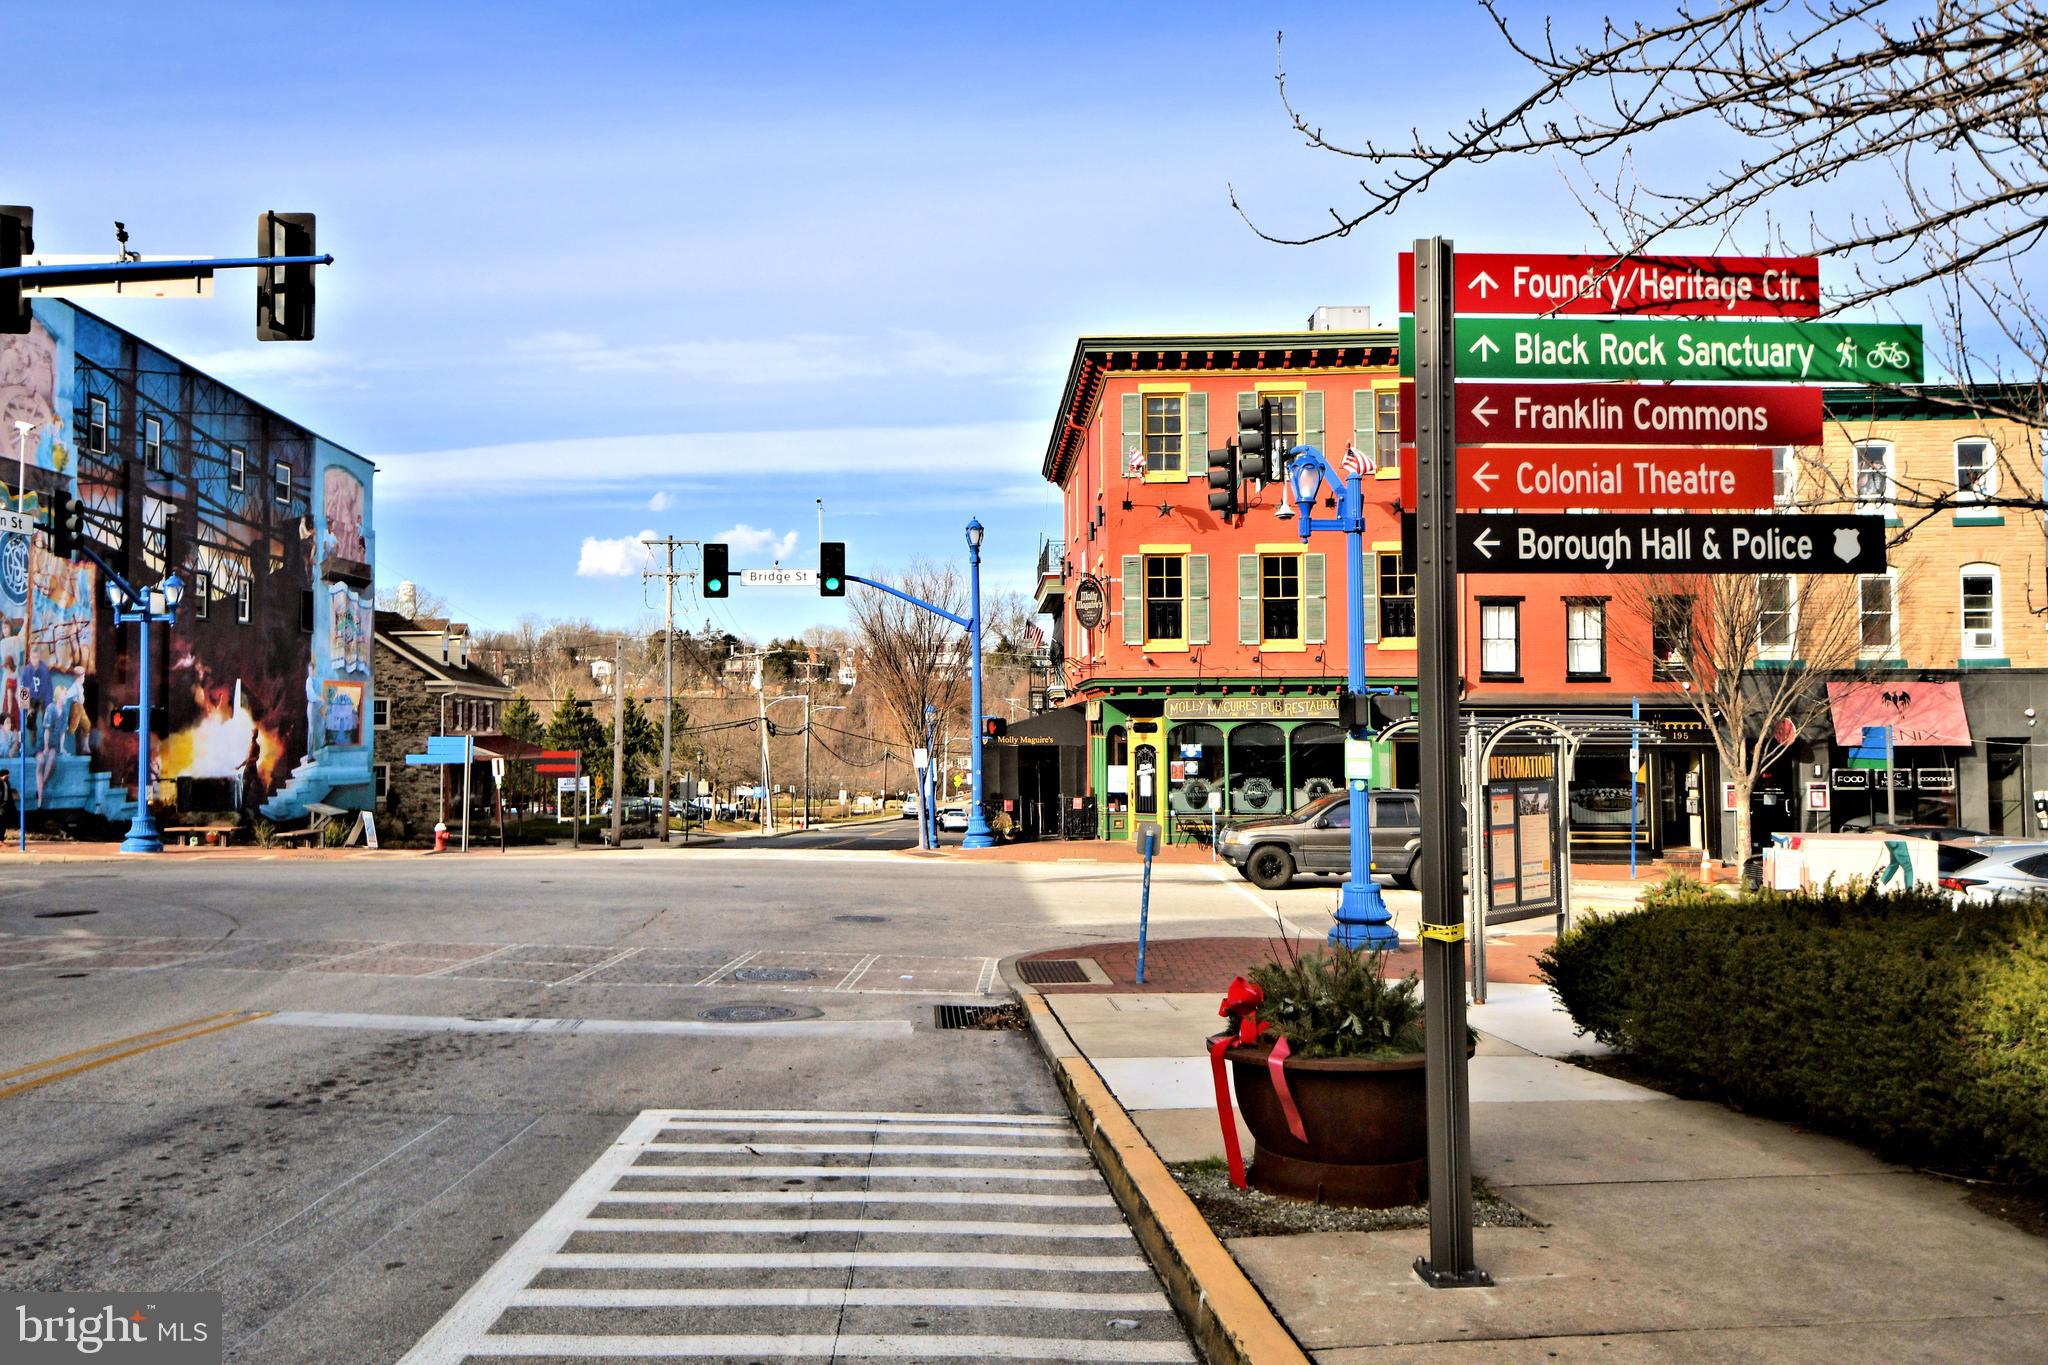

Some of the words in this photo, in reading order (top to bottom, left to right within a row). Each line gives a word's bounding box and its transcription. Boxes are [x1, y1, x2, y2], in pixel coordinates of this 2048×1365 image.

[1513, 266, 1752, 310] Foundry/Heritage
[1762, 269, 1805, 301] Ctr.
[1514, 332, 1589, 366] Black
[1600, 332, 1667, 366] Rock
[1677, 334, 1815, 378] Sanctuary
[1514, 397, 1624, 430] Franklin
[1633, 398, 1768, 431] Commons
[1516, 462, 1622, 495] Colonial
[1633, 462, 1736, 495] Theatre
[11, 516, 23, 530] St
[1517, 527, 1631, 570] Borough
[1641, 527, 1691, 560] Hall
[1702, 528, 1721, 560] &
[1732, 527, 1813, 560] Police
[750, 571, 791, 584] Bridge
[795, 571, 807, 581] St
[1169, 700, 1205, 716] MOLLY
[1260, 700, 1284, 716] PUB
[1284, 699, 1339, 717] RESTAURA
[997, 735, 1019, 745] Molly
[1020, 735, 1054, 746] Maguire's
[1672, 731, 1689, 740] 195
